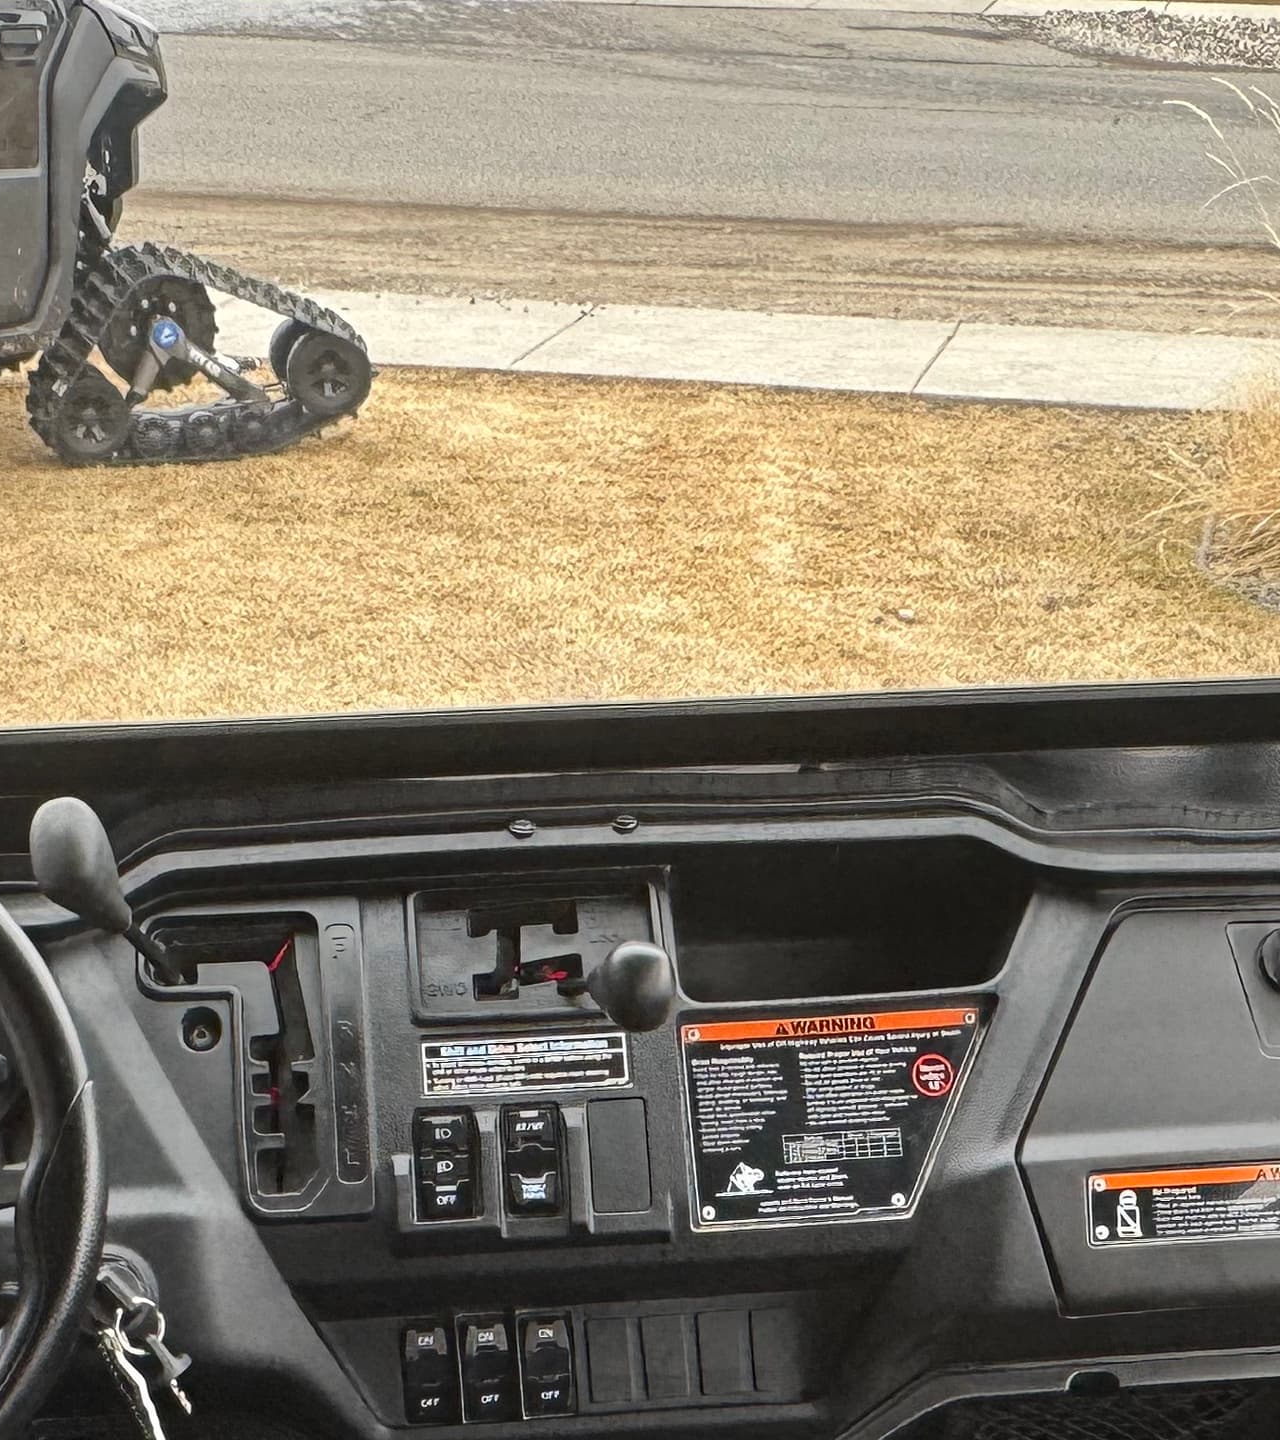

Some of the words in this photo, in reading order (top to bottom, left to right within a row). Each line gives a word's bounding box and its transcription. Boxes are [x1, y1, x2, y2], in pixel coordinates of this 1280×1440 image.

[793, 1017, 876, 1034] WARNING
[436, 1194, 457, 1205] OFF
[477, 1331, 494, 1342] ON
[538, 1328, 553, 1338] ON
[481, 1394, 499, 1404] OFF
[541, 1390, 560, 1400] OFF
